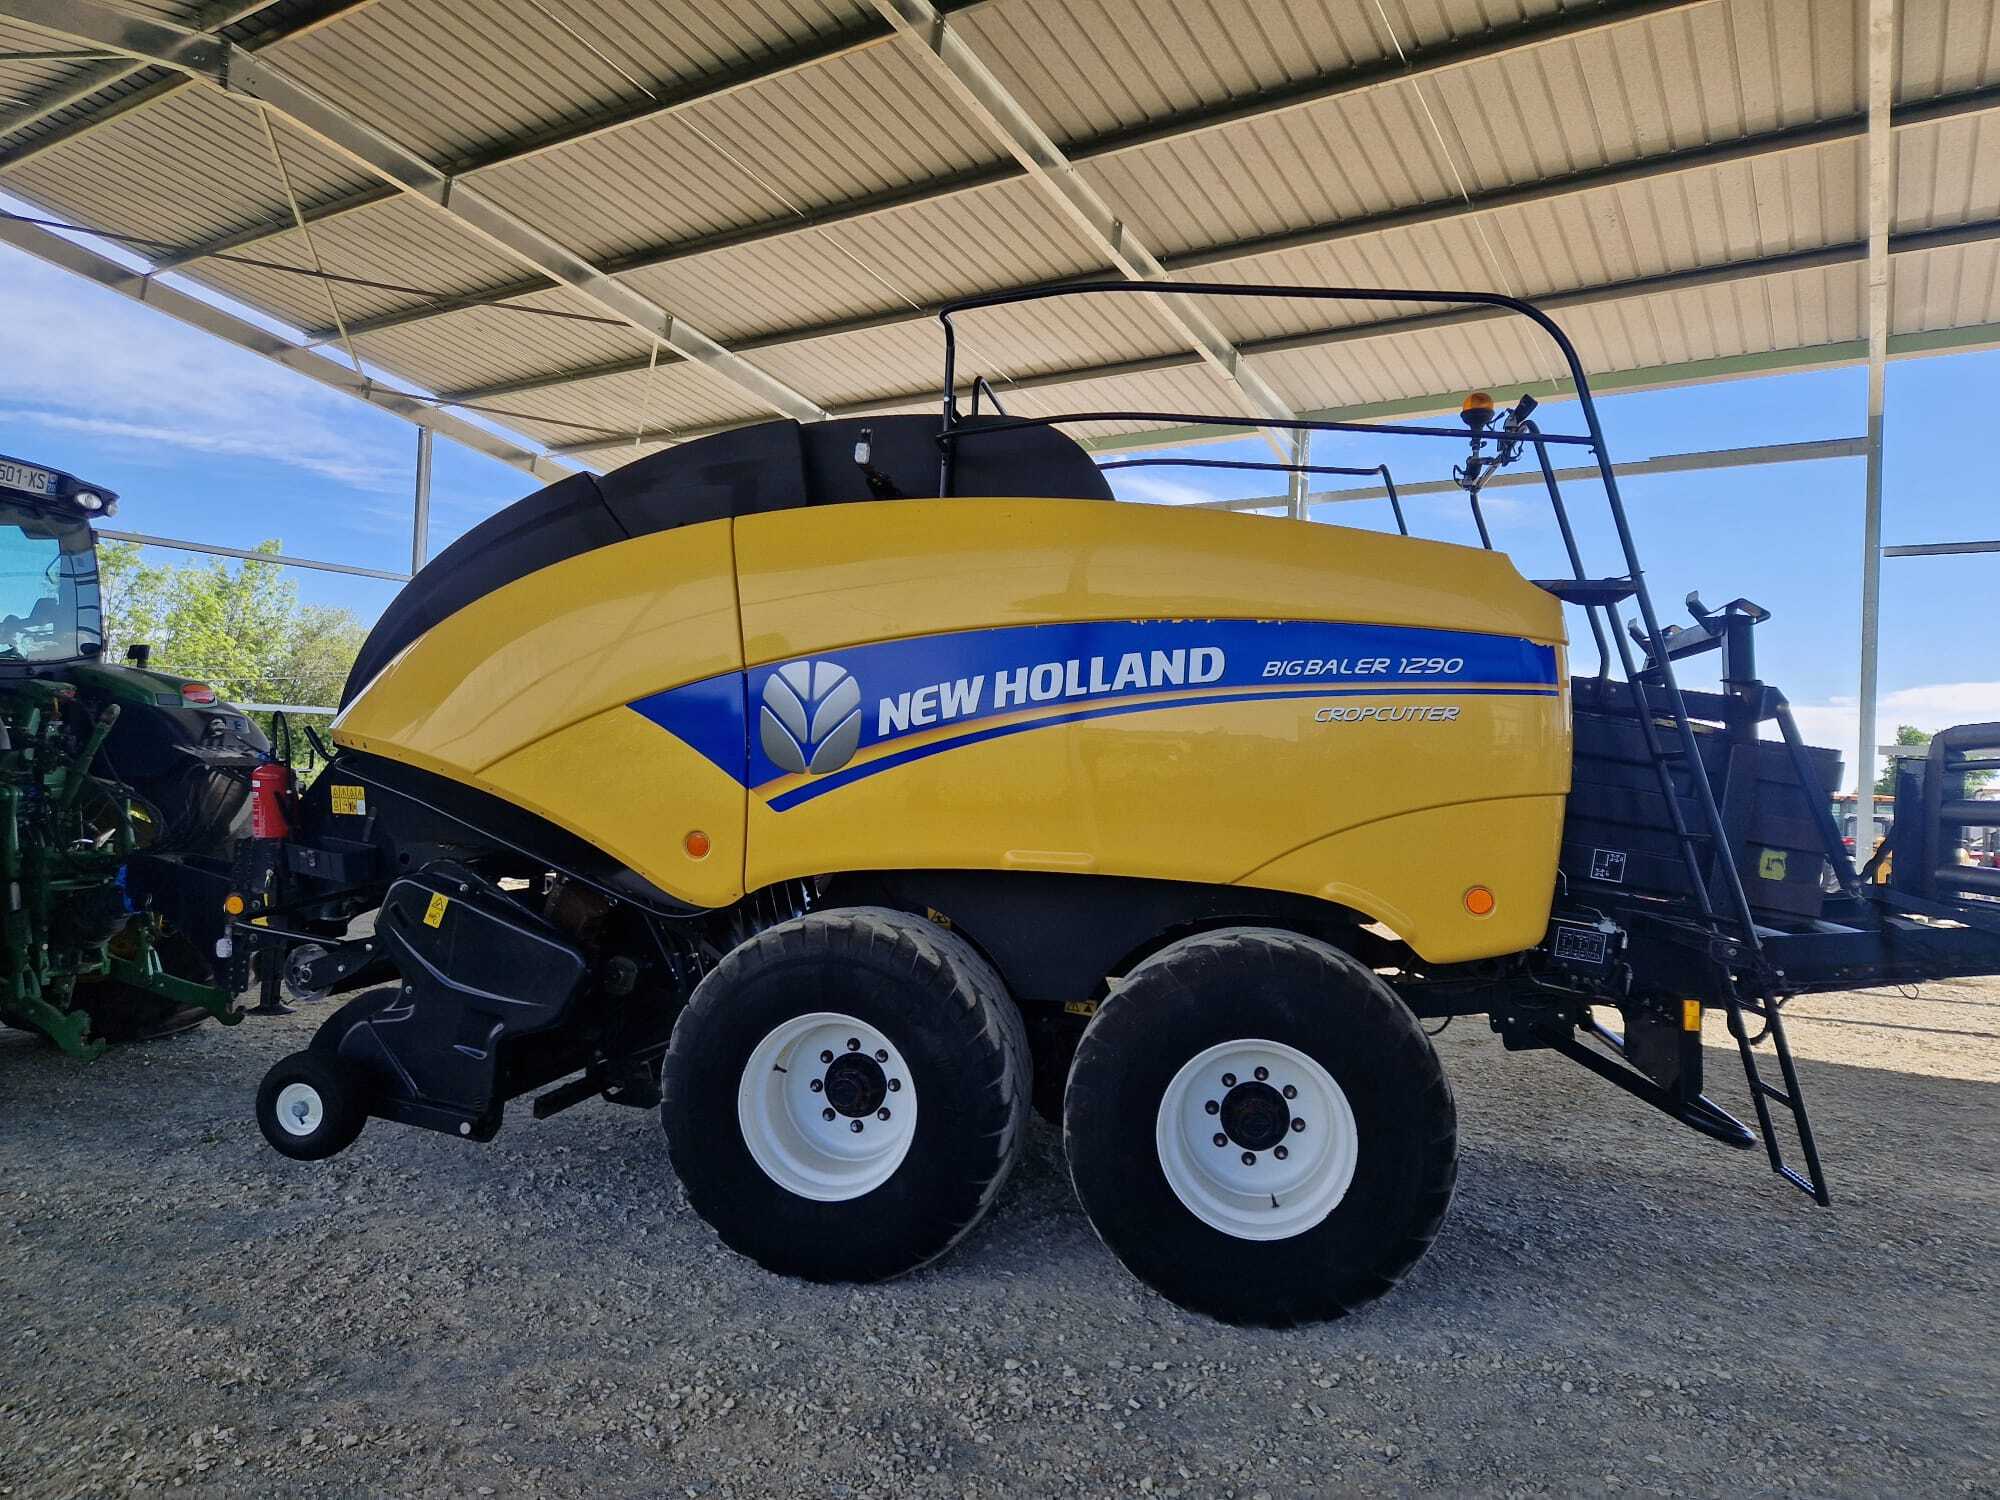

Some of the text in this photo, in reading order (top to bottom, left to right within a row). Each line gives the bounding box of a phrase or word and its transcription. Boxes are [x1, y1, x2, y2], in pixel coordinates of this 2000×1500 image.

[1262, 657, 1463, 677] BIGBALER 1290
[878, 646, 1225, 737] NEW HOLLAND
[1314, 705, 1460, 723] CROPCUTTER
